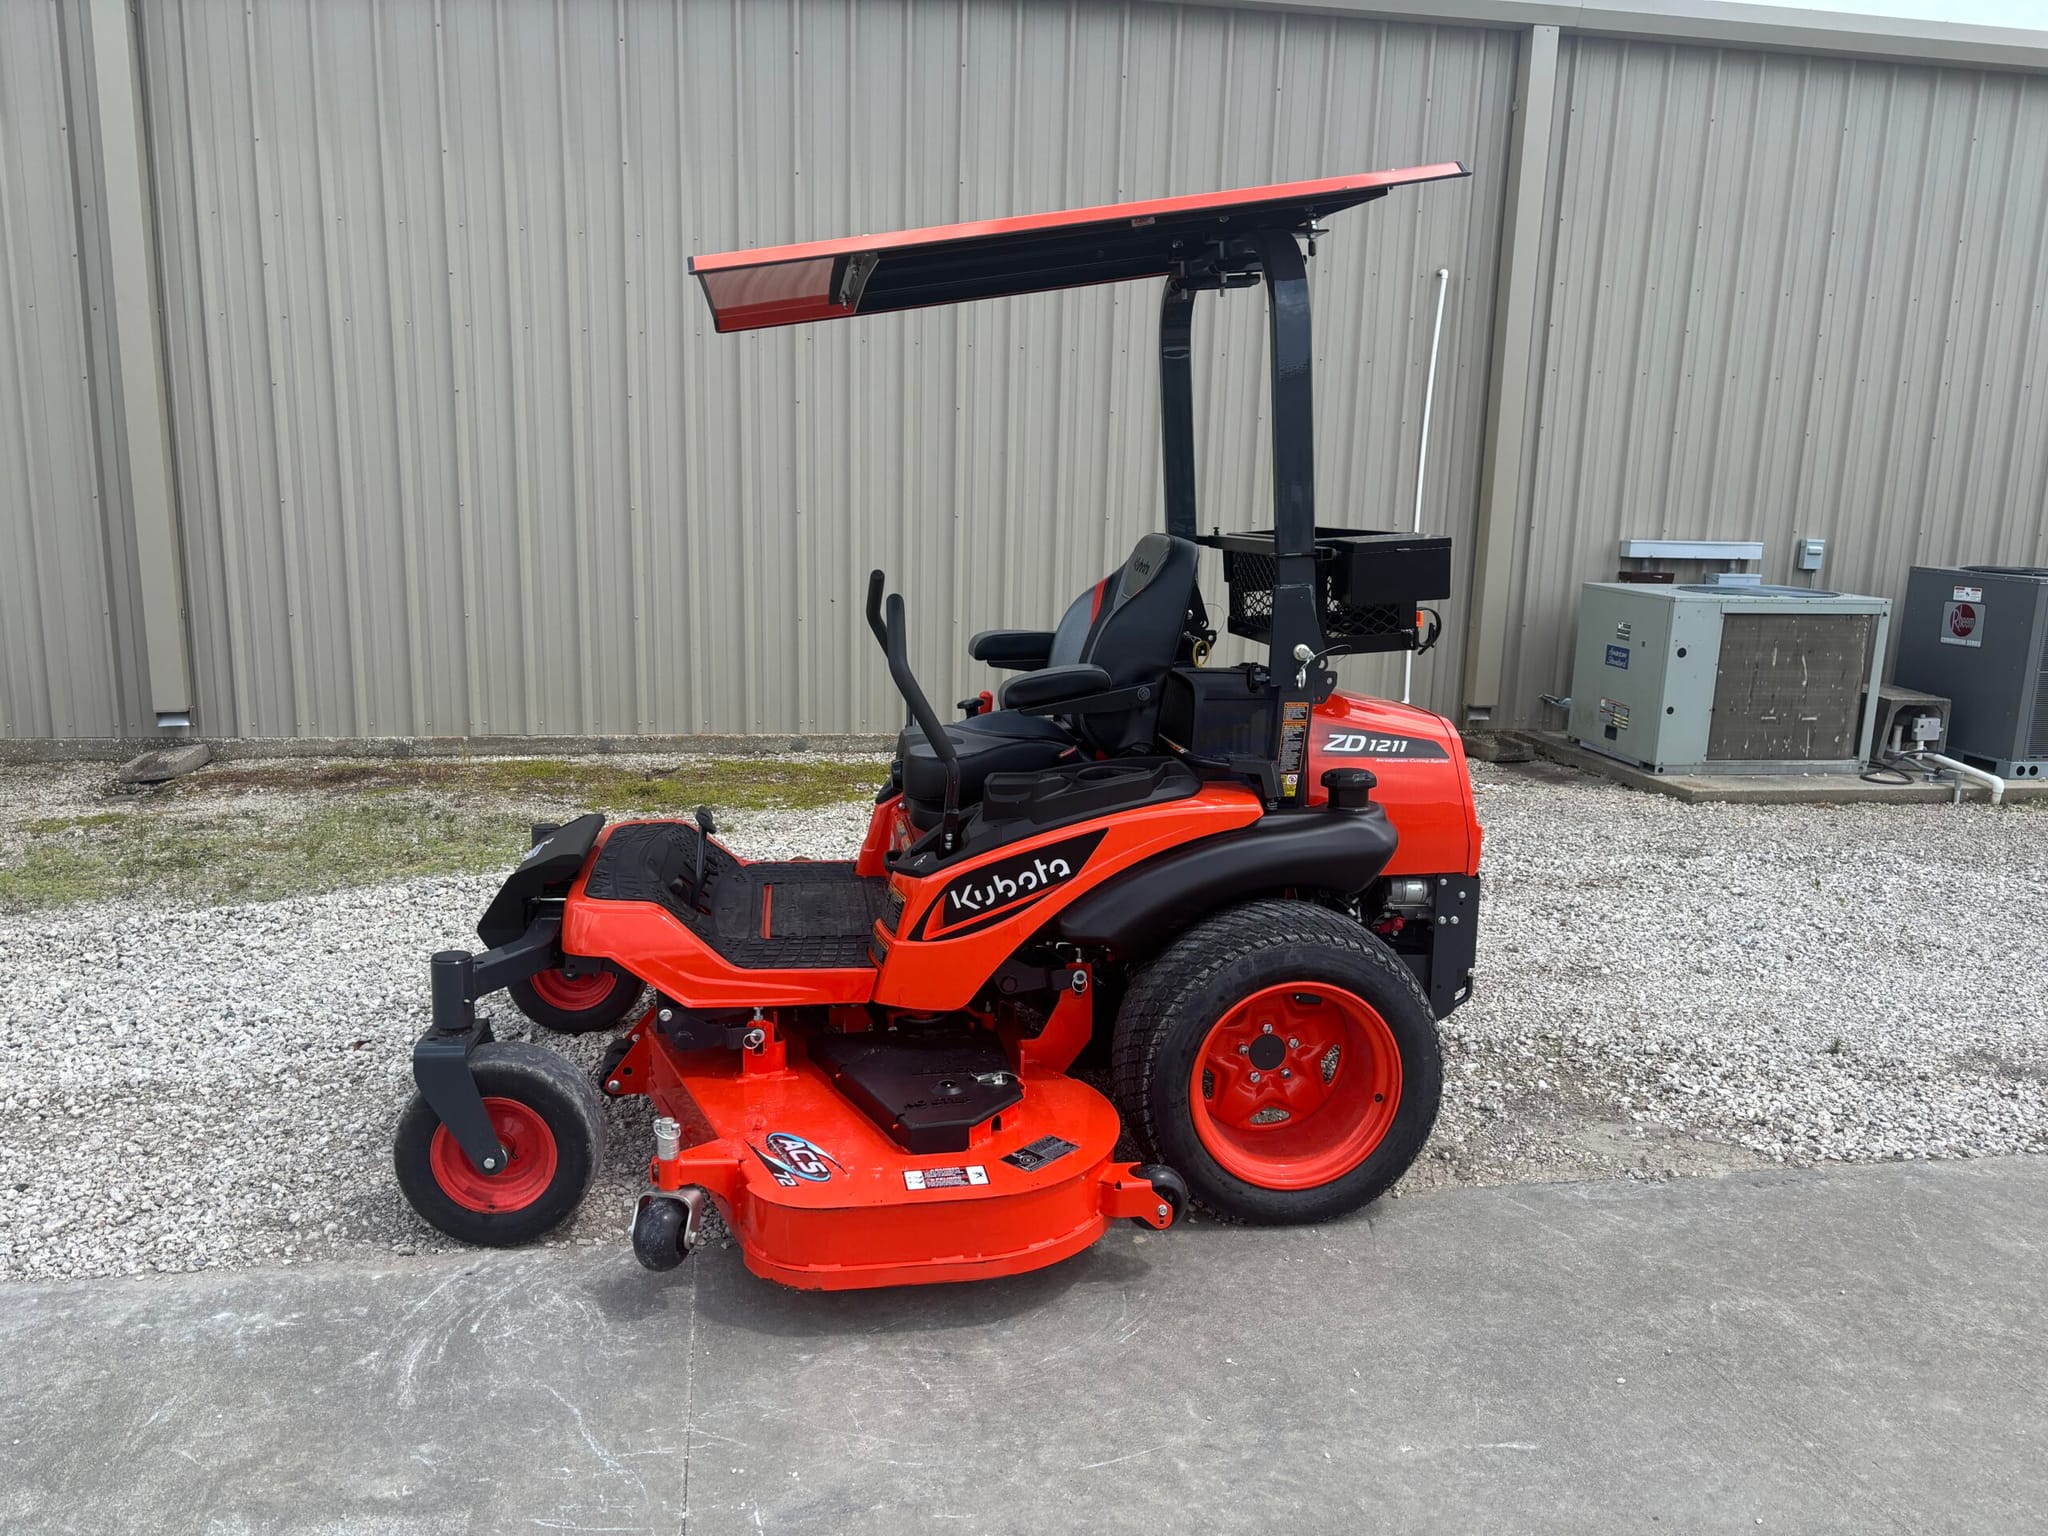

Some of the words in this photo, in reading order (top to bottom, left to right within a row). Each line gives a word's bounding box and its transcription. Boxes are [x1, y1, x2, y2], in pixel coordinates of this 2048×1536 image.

[1951, 603, 1975, 633] Rheem
[950, 857, 1072, 911] Kubota
[776, 1138, 828, 1174] ACS
[773, 1171, 798, 1187] 72
